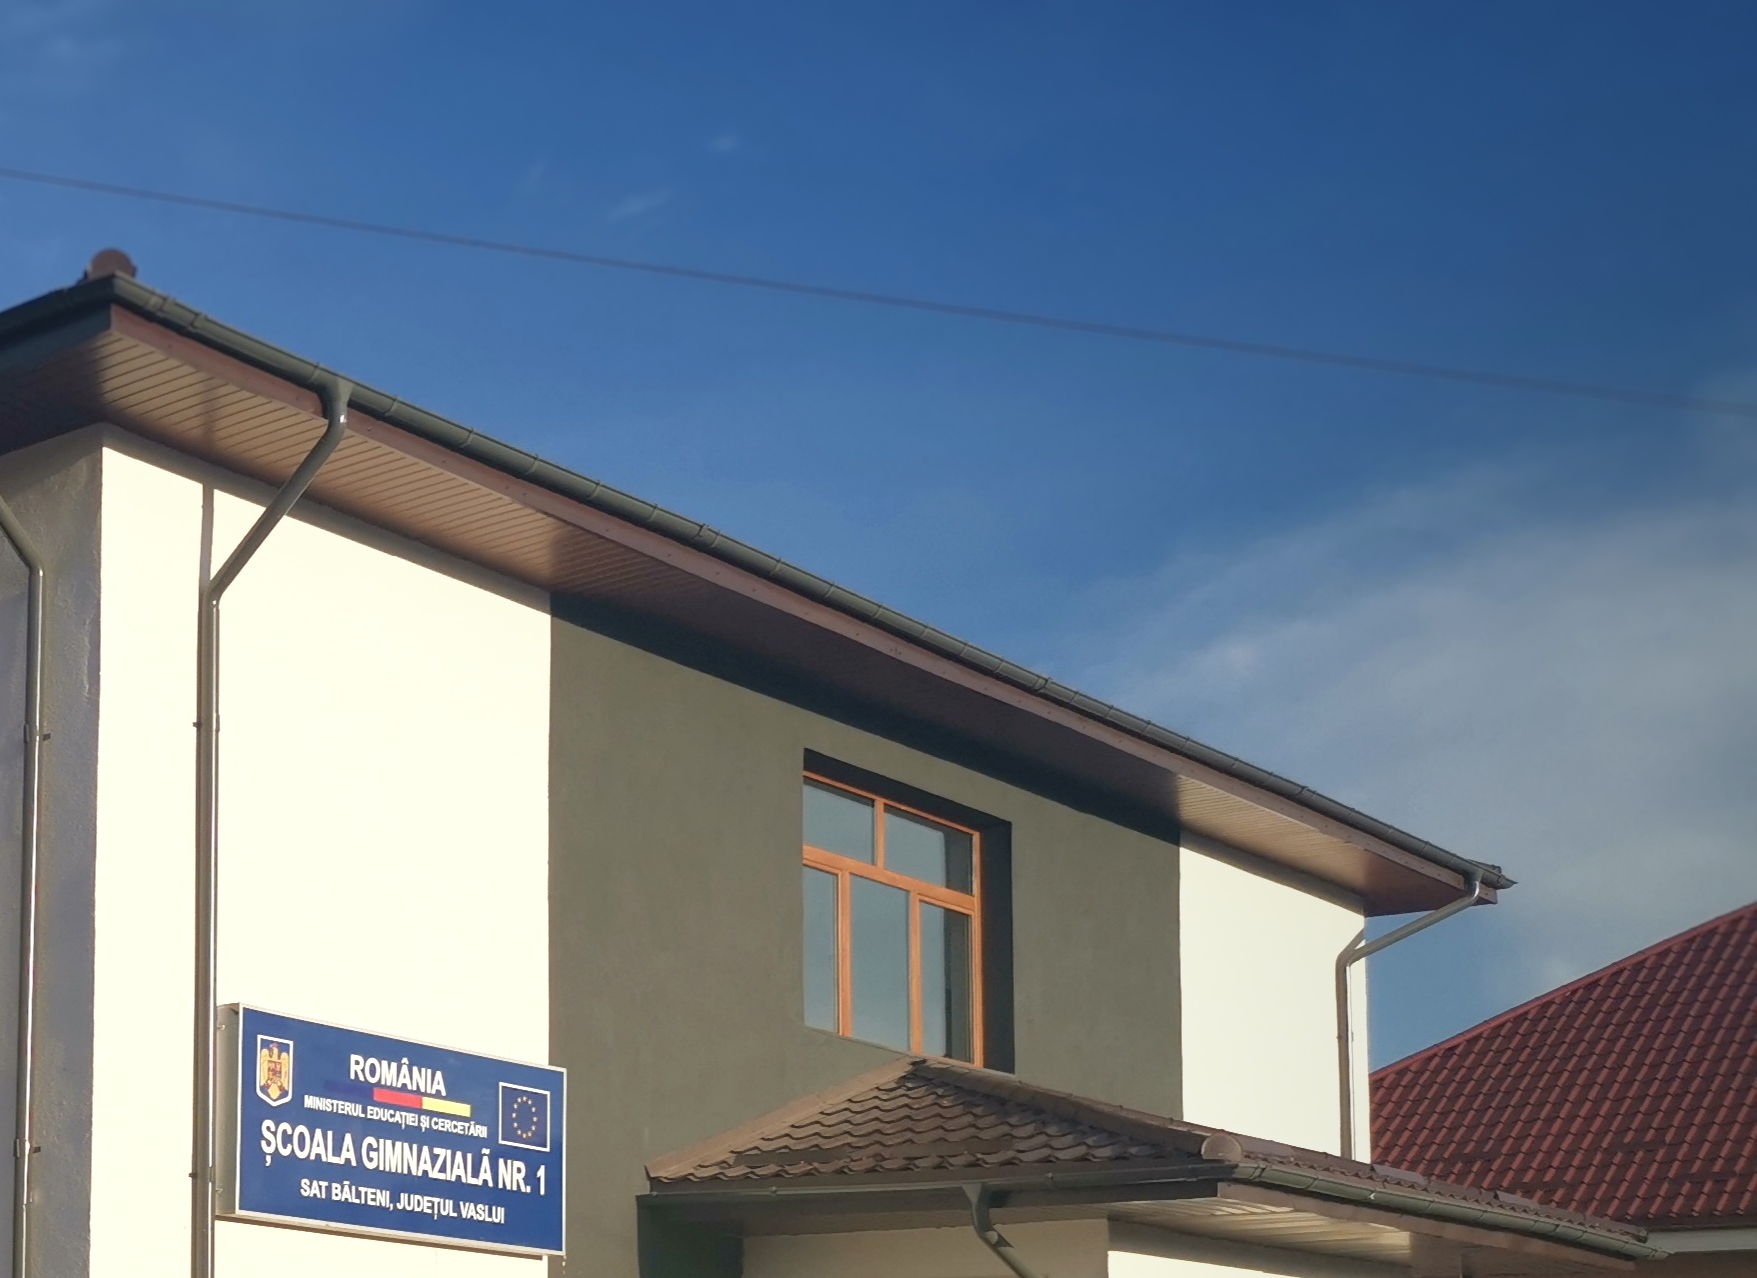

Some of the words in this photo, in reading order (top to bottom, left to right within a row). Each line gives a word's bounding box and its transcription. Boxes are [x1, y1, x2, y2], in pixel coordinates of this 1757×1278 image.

[349, 1053, 447, 1097] ROMÂNIA
[303, 1094, 366, 1118] MINISTERUL
[260, 1119, 358, 1167] ȘCOALA
[497, 1157, 532, 1194] NR.
[536, 1164, 546, 1196] 1
[300, 1178, 329, 1200] SAT
[396, 1192, 458, 1221] JUDEȚUL
[459, 1200, 505, 1224] VASLUI
